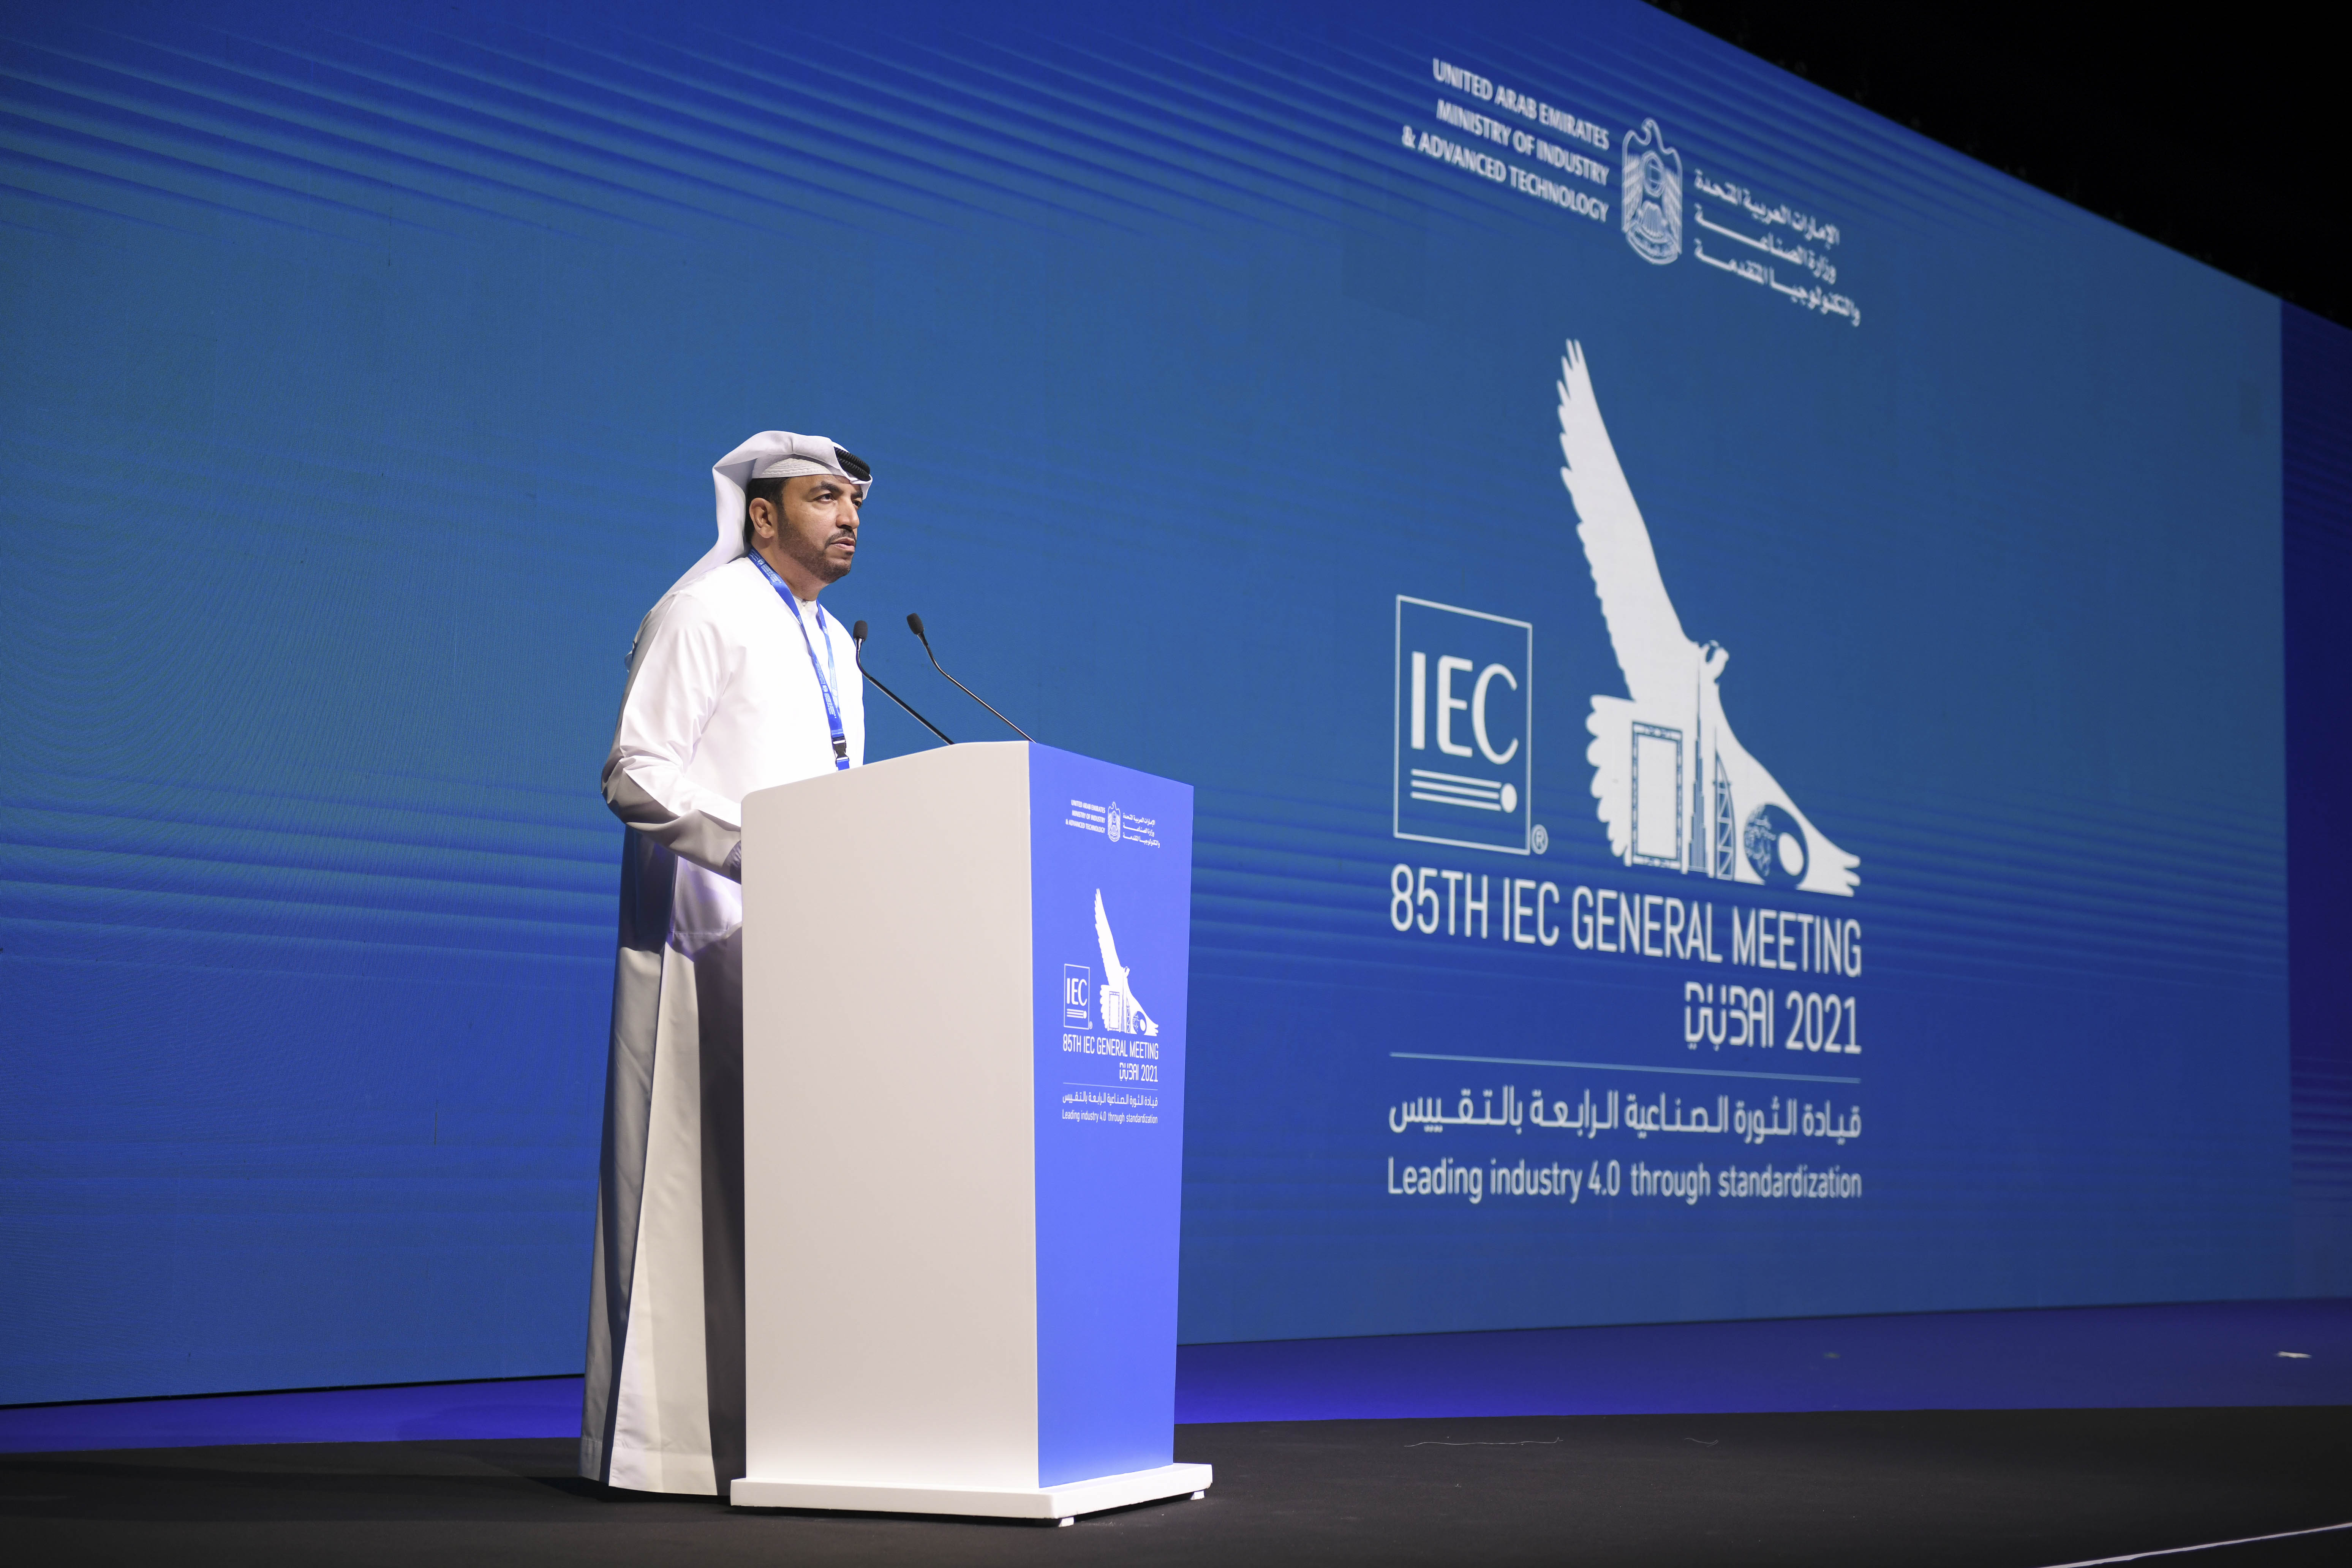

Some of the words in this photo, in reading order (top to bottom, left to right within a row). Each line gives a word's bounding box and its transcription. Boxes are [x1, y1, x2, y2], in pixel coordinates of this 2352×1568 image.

[1434, 59, 1492, 100] UNITED
[1495, 87, 1536, 119] ARAB
[1540, 104, 1609, 149] EMIRATES
[1437, 100, 1511, 145] MINISTRY
[1513, 131, 1534, 155] OF
[1537, 141, 1609, 185] INDUSTRY
[1402, 126, 1415, 148] &
[1419, 133, 1506, 181] ADVANCED
[1510, 166, 1608, 221] TECHNOLOGY
[1696, 171, 1740, 204] المتحدة
[1744, 190, 1790, 223] العربية
[1696, 205, 1806, 264] الصناعة
[1809, 250, 1835, 283] وزارة
[1412, 652, 1518, 764] IEC
[1072, 810, 1086, 819] MINISTRY
[1091, 815, 1105, 823] INDUSTRY
[1091, 805, 1105, 813] EMIRATES
[1069, 820, 1085, 828] ADVANCED
[1085, 824, 1105, 833] TECHNOLOGY
[1391, 864, 1487, 938] 85TH
[1504, 878, 1559, 946] IEC
[1573, 887, 1722, 962] GENERAL
[1734, 908, 1860, 977] MEETING
[1067, 978, 1087, 1006] IEC
[1686, 983, 1773, 1050] DUBAI
[1787, 991, 1860, 1053] 2021
[1063, 1034, 1081, 1052] 85TH
[1084, 1036, 1095, 1054] IEC
[1097, 1037, 1128, 1057] GENERAL
[1130, 1041, 1158, 1059] MEETING
[1120, 1062, 1138, 1081] DUBAI
[1141, 1064, 1158, 1082] 2021
[1089, 1092, 1106, 1105] الرابعة
[1107, 1094, 1129, 1105] الصناعية
[1130, 1095, 1143, 1108] الثورة
[1145, 1096, 1158, 1108] قيادة
[1389, 1086, 1522, 1133] بالتقييس
[1530, 1090, 1618, 1138] الرابعة
[1062, 1110, 1080, 1122] Leading
[1081, 1111, 1099, 1122] industry
[1108, 1112, 1124, 1124] through
[1126, 1114, 1157, 1123] standardization
[1626, 1094, 1728, 1138] الصناعية
[1736, 1097, 1796, 1144] الثورة
[1804, 1103, 1860, 1144] قيادة
[1389, 1158, 1482, 1203] Leading
[1491, 1159, 1582, 1203] industry
[1589, 1160, 1620, 1196] 4.0
[1631, 1163, 1710, 1204] through
[1719, 1166, 1861, 1197] standardization
